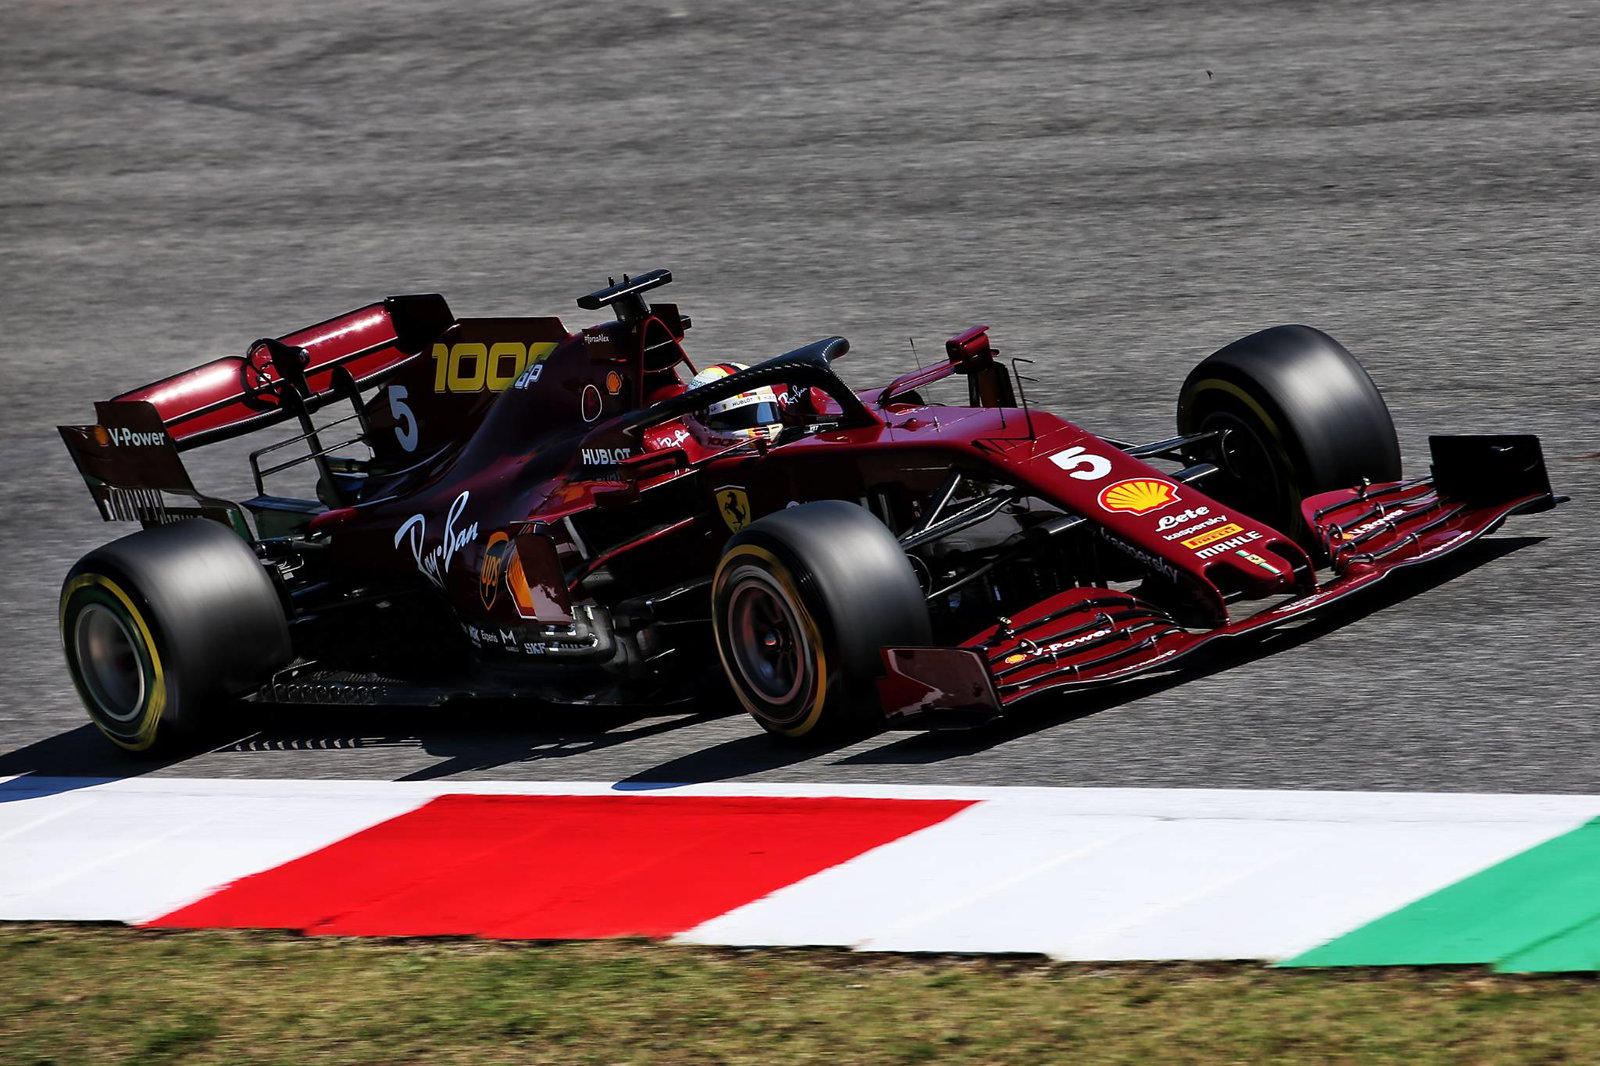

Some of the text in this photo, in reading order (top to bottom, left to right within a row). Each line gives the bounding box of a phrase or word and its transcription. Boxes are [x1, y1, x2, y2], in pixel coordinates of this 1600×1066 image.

[388, 384, 418, 452] 5
[107, 427, 165, 447] V-Power
[581, 448, 631, 466] HUBLOT
[1047, 446, 1112, 480] 5
[1155, 505, 1210, 532] Lete
[1162, 514, 1228, 541] kaspersky
[524, 642, 547, 656] SKF
